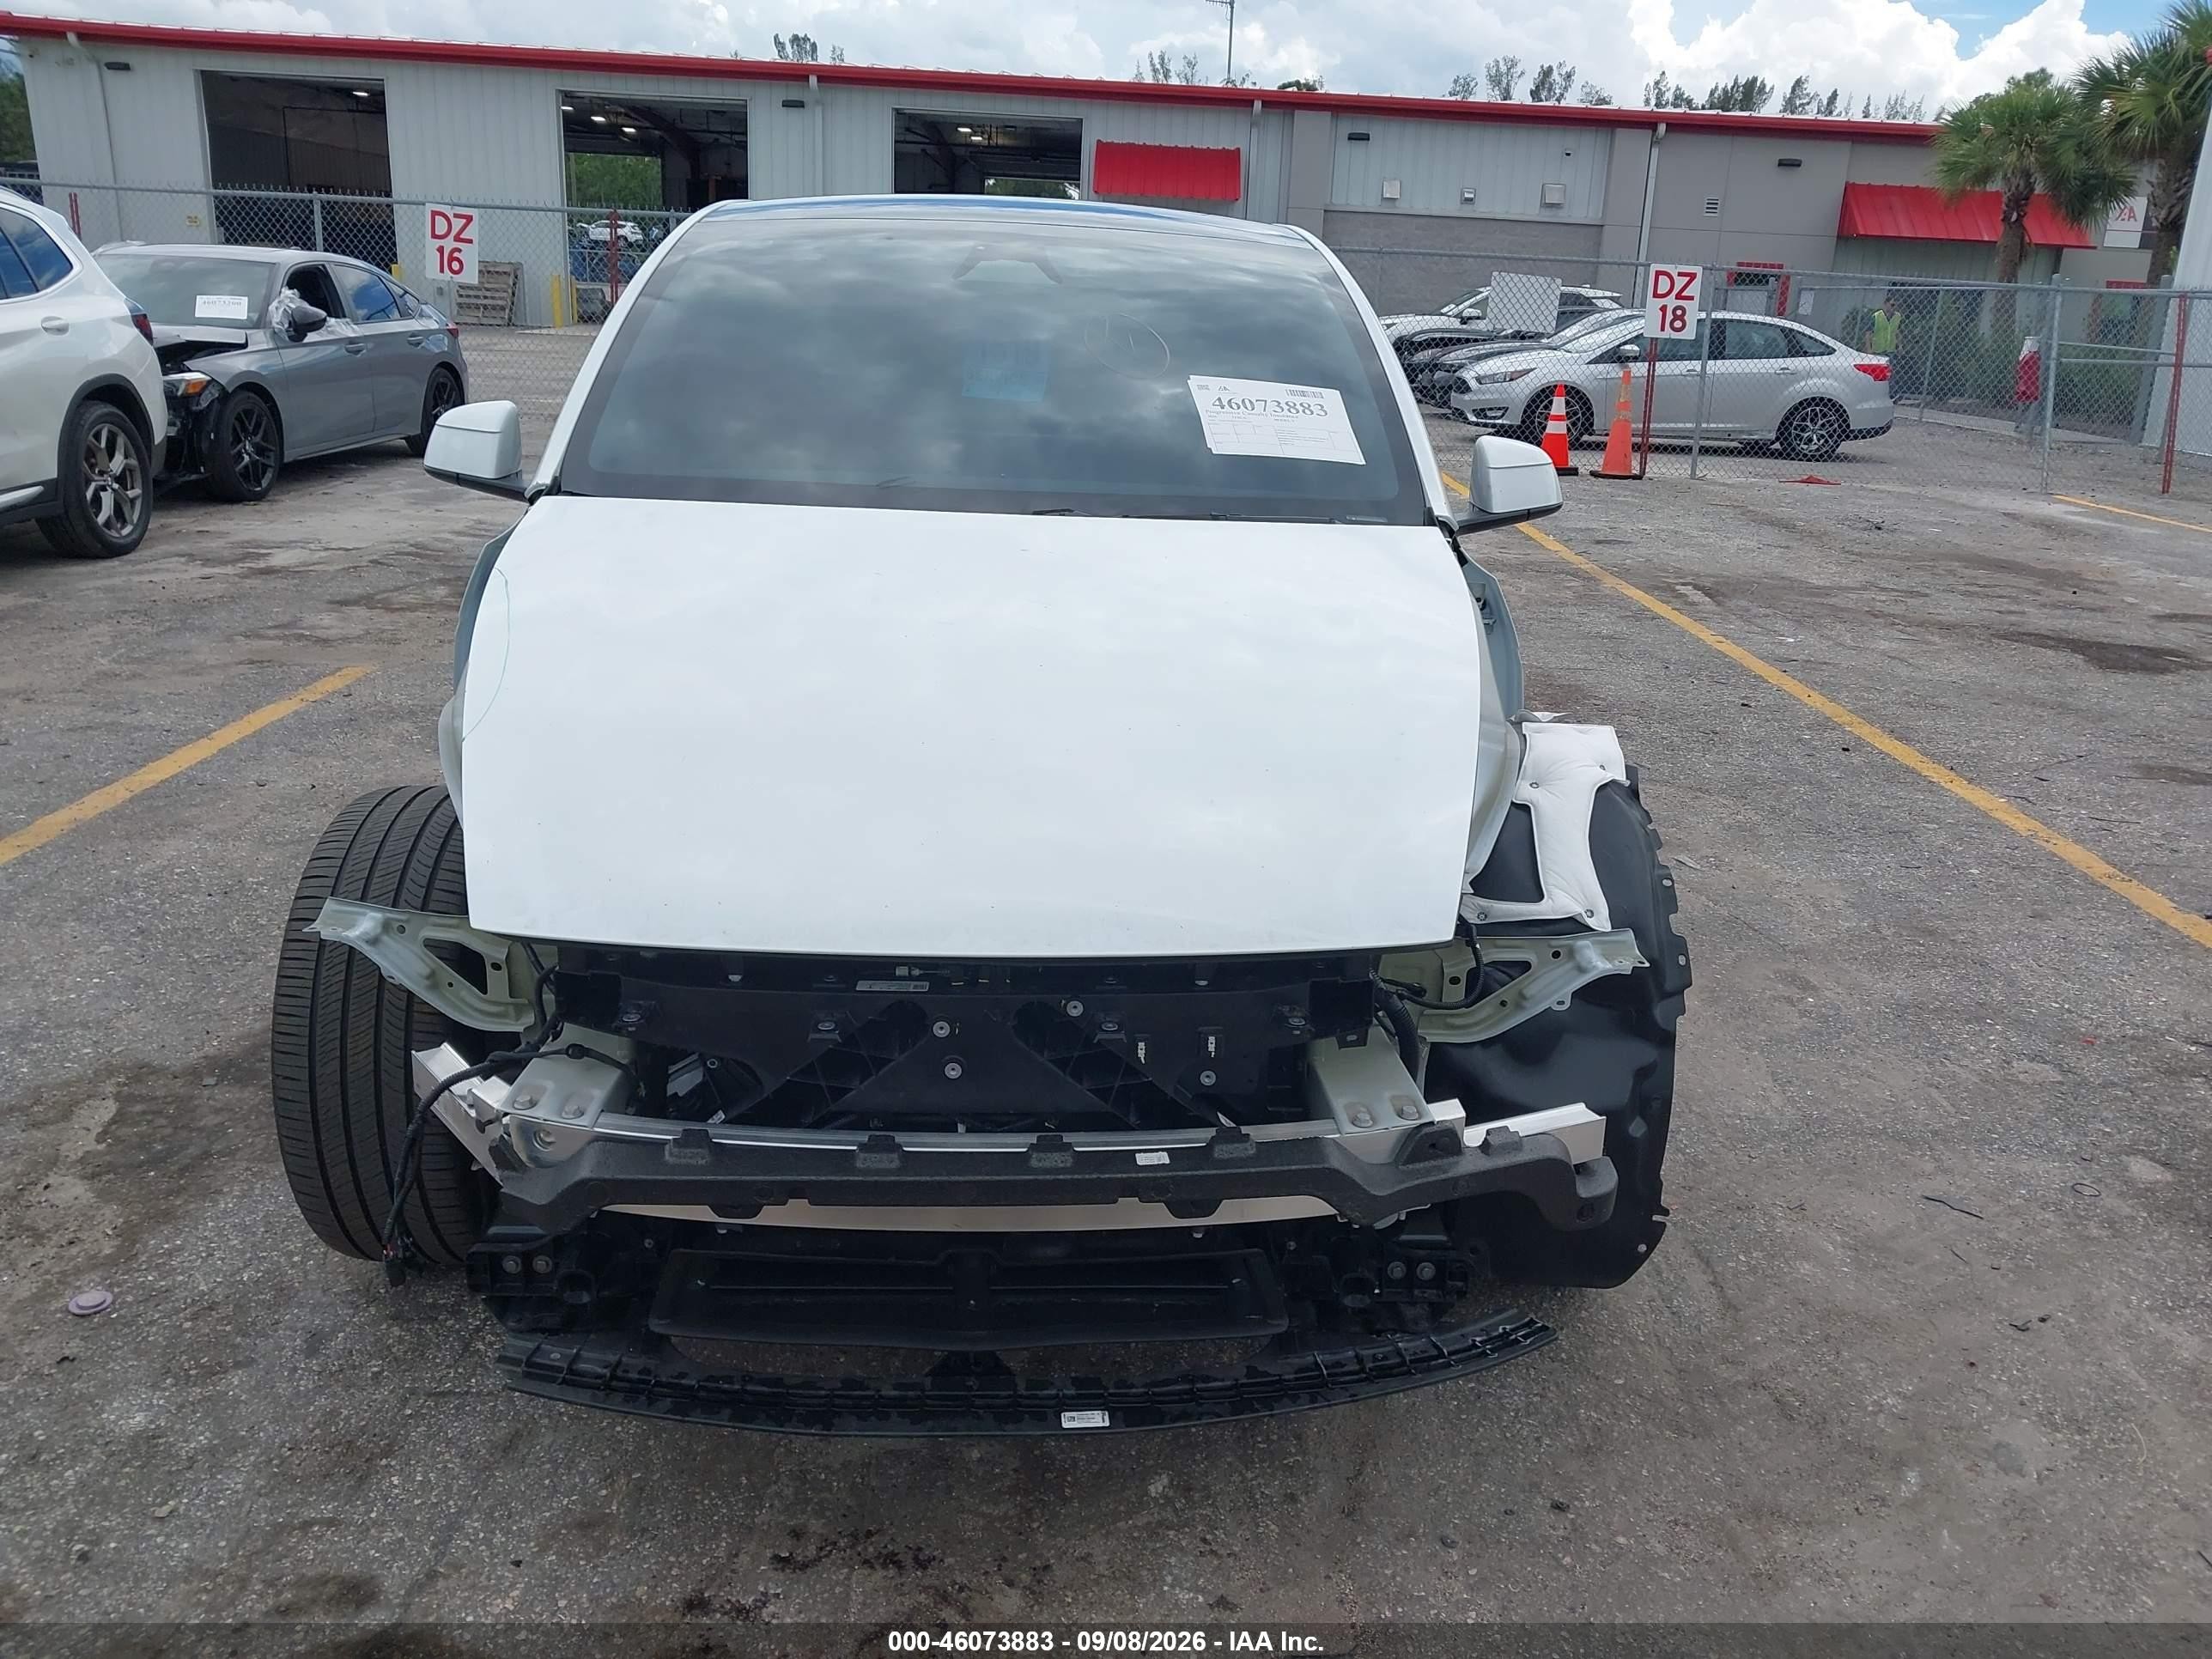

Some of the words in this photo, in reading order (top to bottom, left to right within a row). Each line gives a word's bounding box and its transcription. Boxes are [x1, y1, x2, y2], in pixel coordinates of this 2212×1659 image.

[430, 210, 473, 244] DZ
[435, 245, 465, 276] 16
[1652, 270, 1698, 301] DZ
[1658, 304, 1687, 332] 18
[1212, 396, 1328, 417] 46073883
